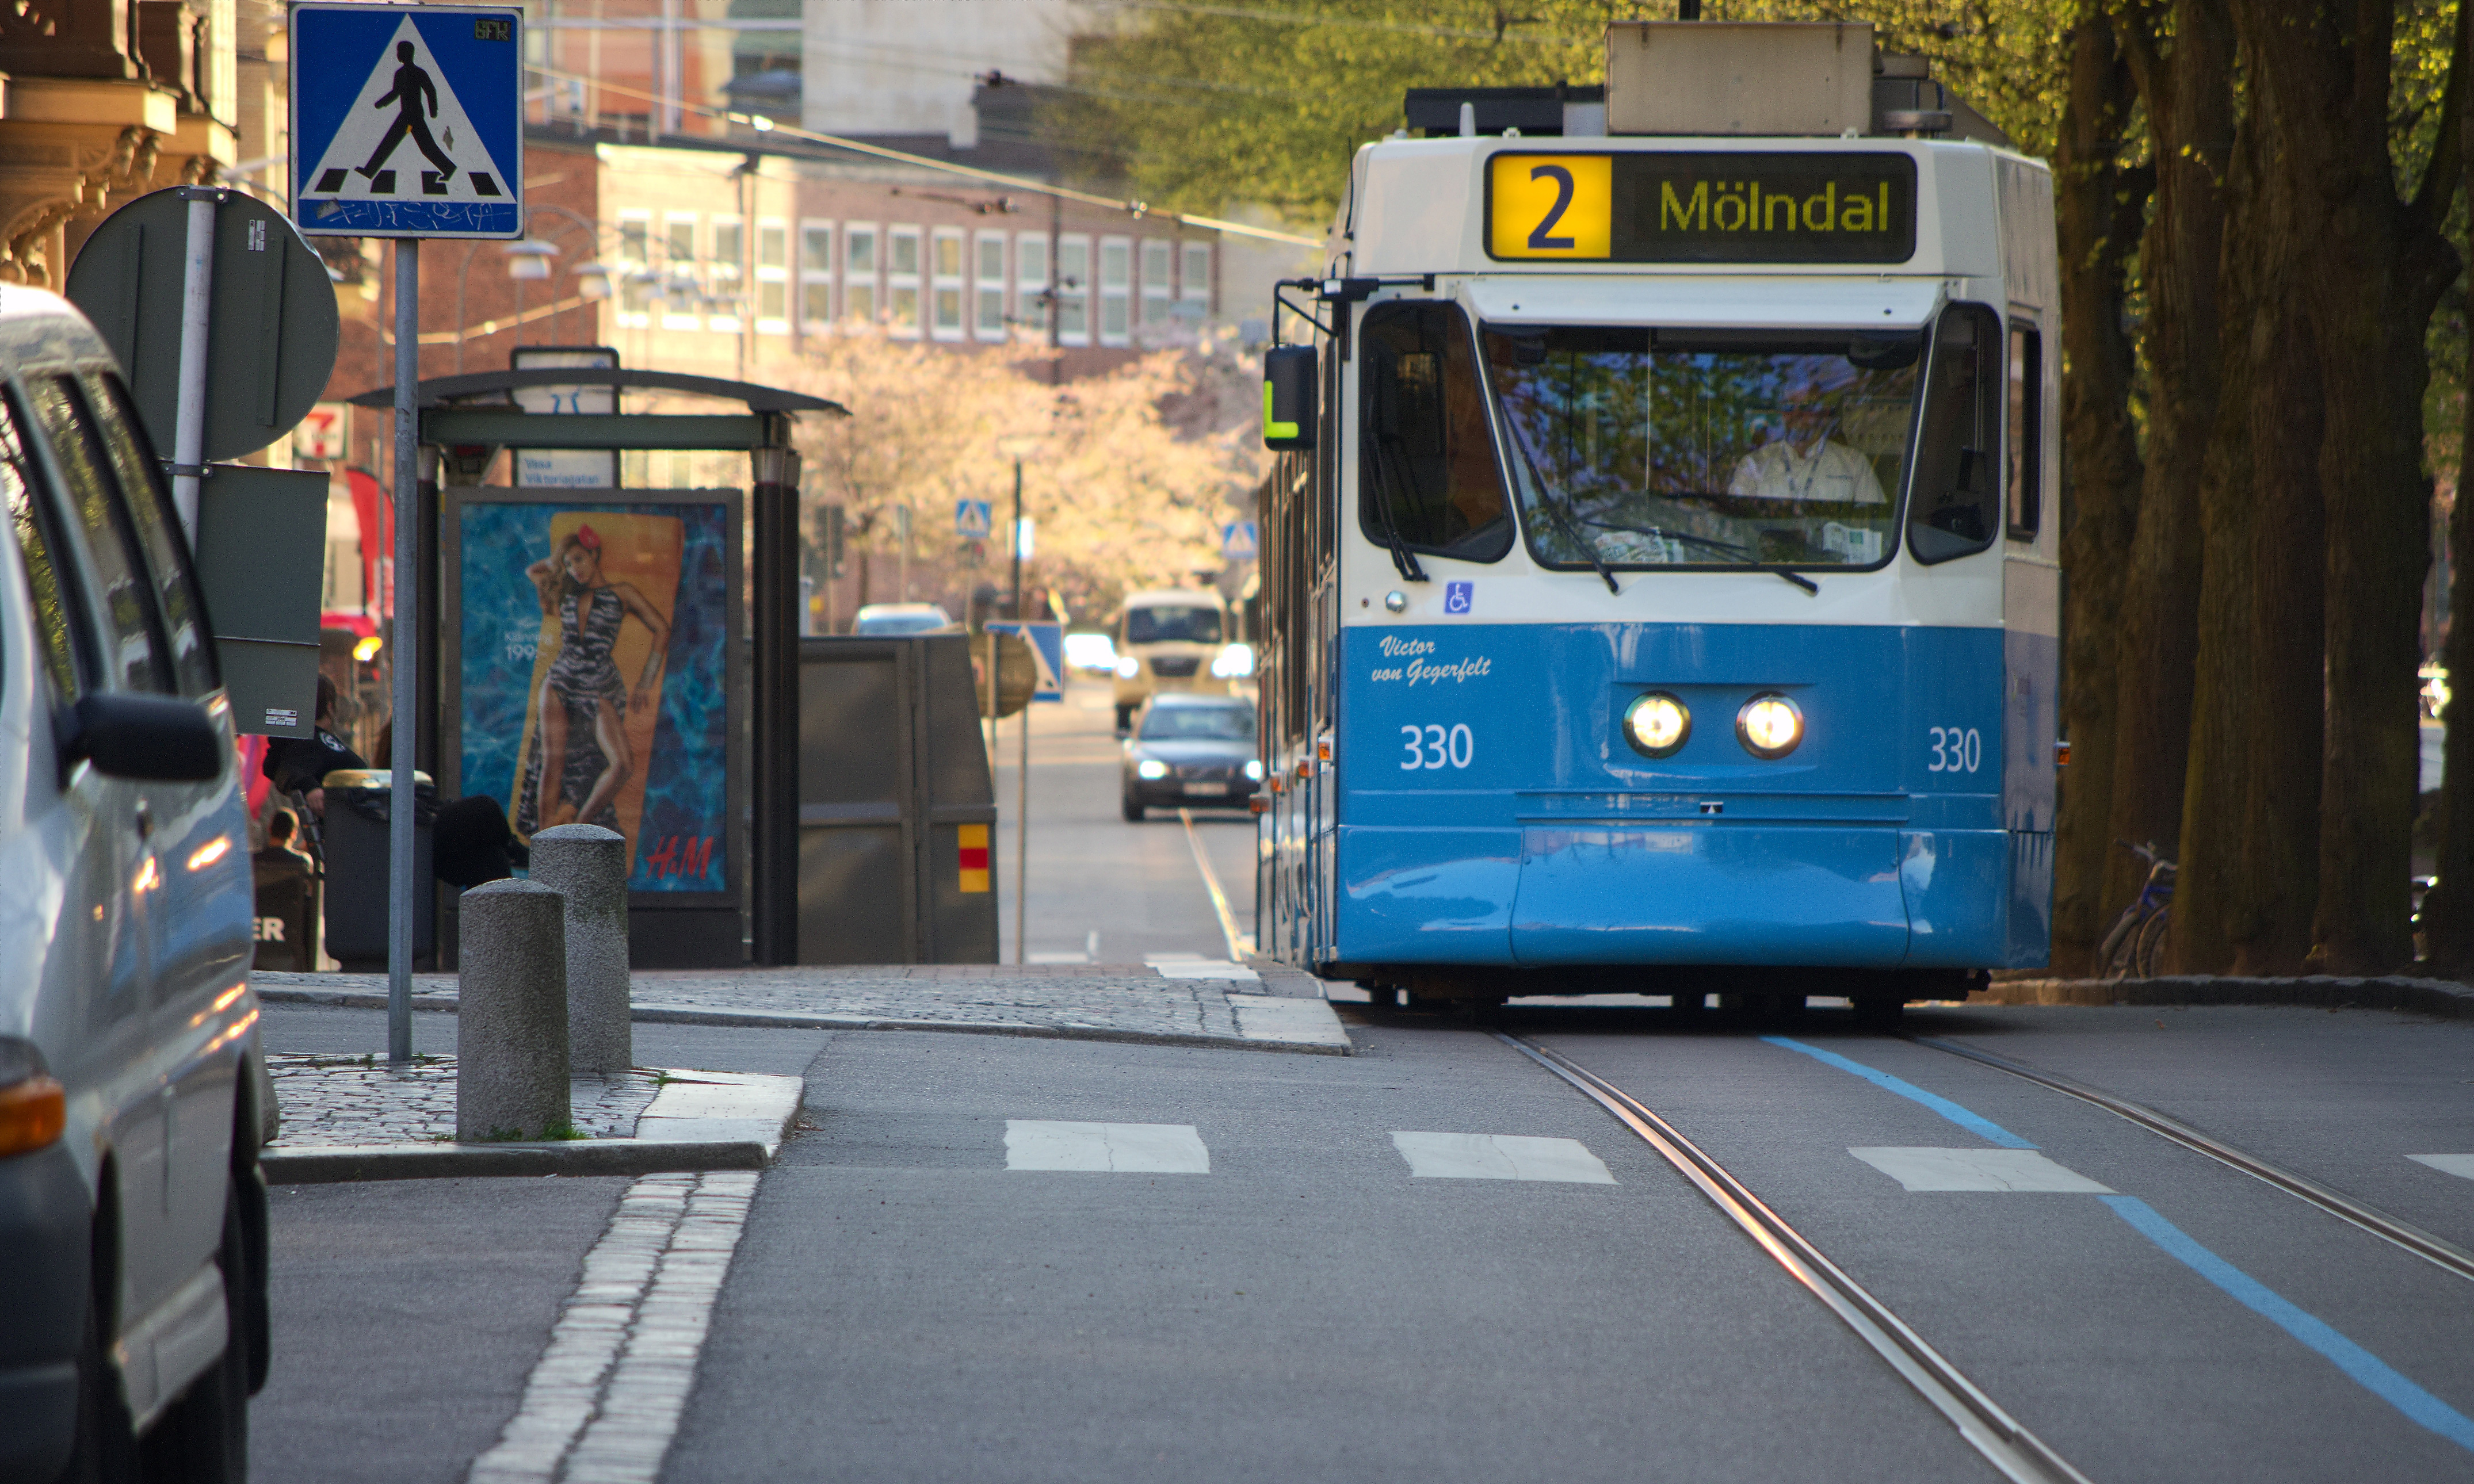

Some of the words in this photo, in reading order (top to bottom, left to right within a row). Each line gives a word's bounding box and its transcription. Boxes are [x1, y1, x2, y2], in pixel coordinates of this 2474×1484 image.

[1527, 165, 1575, 249] 2
[1661, 181, 1888, 231] Mölndal
[1379, 635, 1435, 657] Victor
[1371, 668, 1403, 681] von
[1407, 656, 1492, 687] Gegerfelt
[1400, 724, 1473, 770] 330
[1928, 726, 1981, 773] 330
[645, 835, 715, 880] H&M
